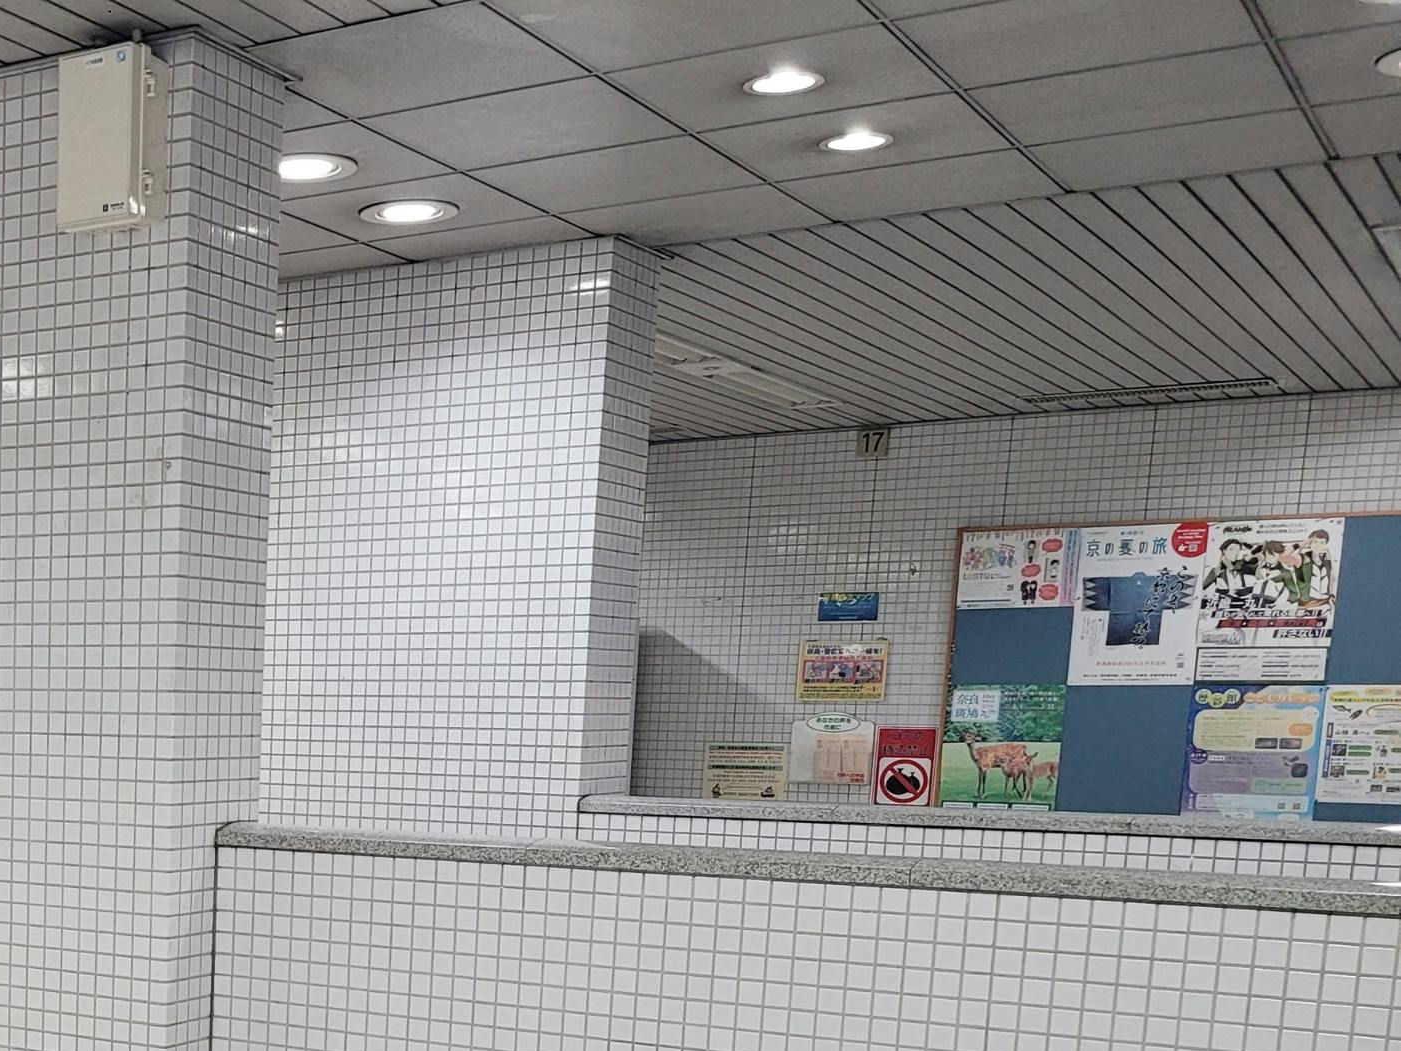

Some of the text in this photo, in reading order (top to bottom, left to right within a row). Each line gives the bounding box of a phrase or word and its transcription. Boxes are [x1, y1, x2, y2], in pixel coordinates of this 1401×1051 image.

[863, 431, 885, 453] 17
[1086, 537, 1168, 557] 京の夏の旅
